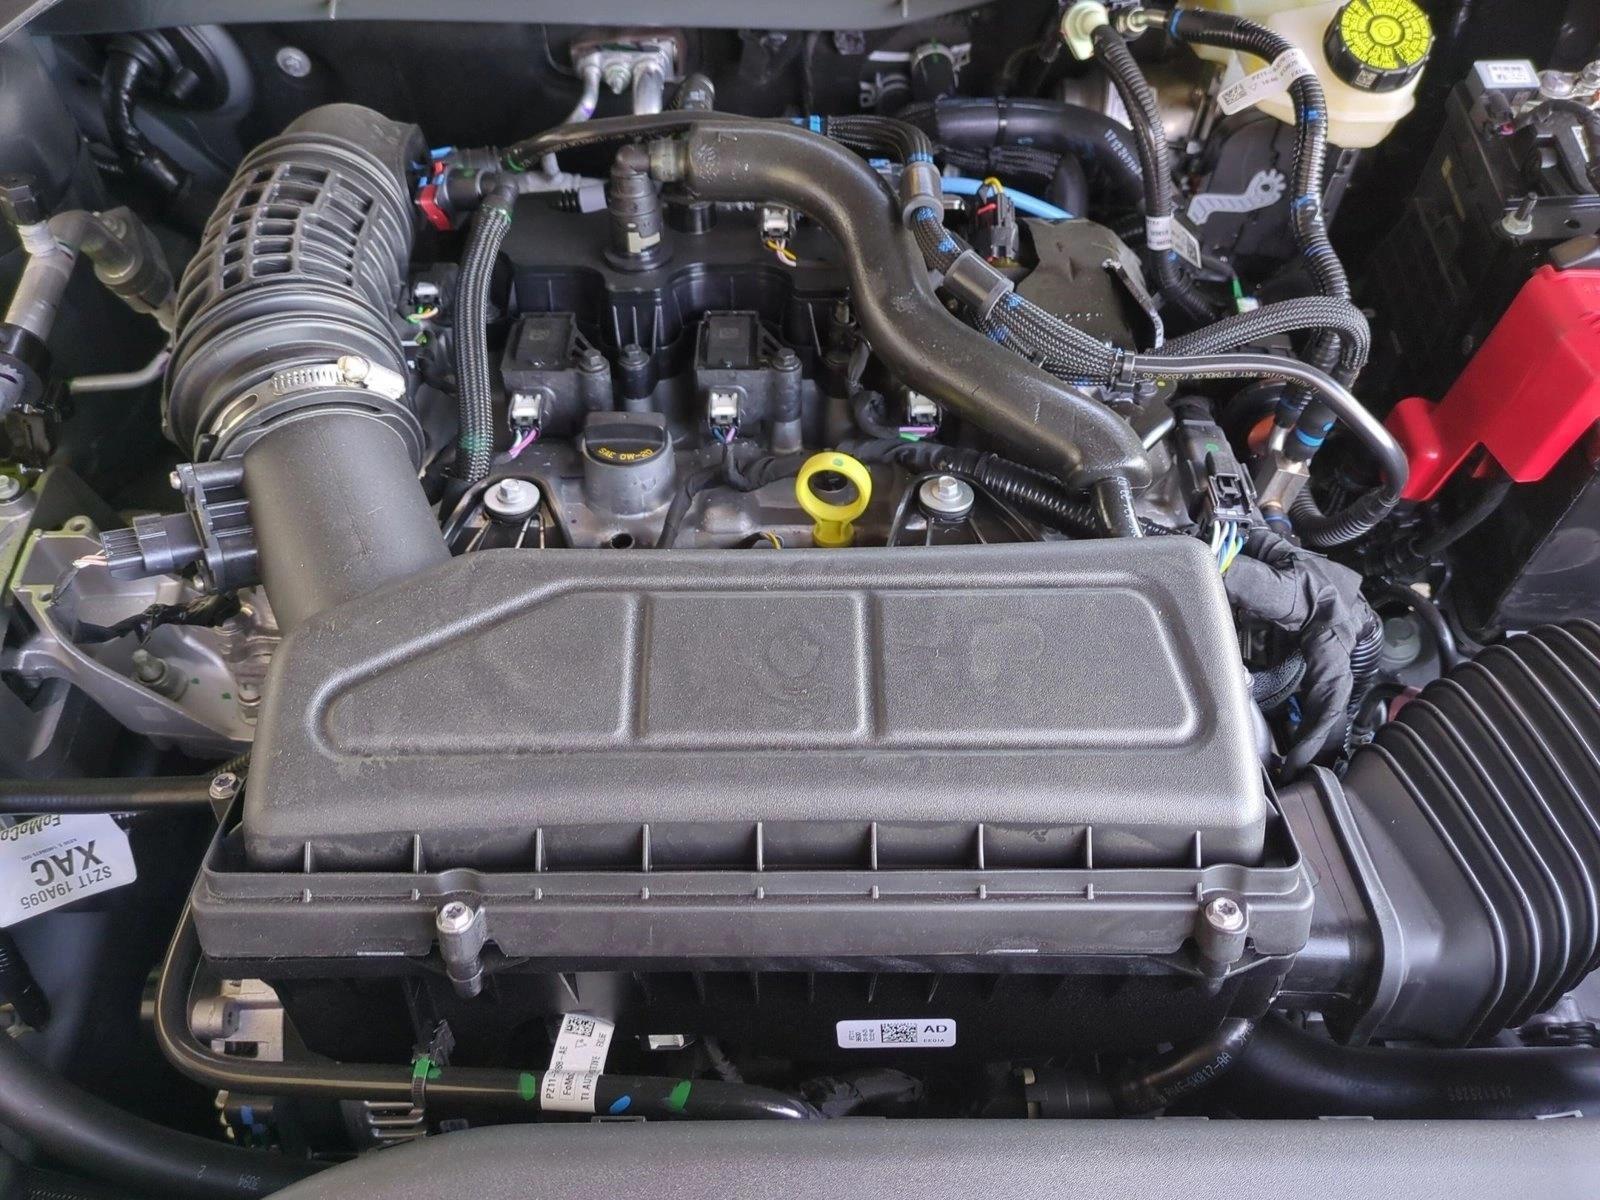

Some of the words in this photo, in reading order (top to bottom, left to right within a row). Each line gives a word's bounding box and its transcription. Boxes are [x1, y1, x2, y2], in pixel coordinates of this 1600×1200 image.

[598, 447, 616, 459] SAE
[0, 814, 61, 841] FoMoCo
[30, 840, 104, 887] XAC
[79, 865, 112, 889] SZ1T
[20, 881, 73, 910] 19A095
[923, 1024, 948, 1034] AD
